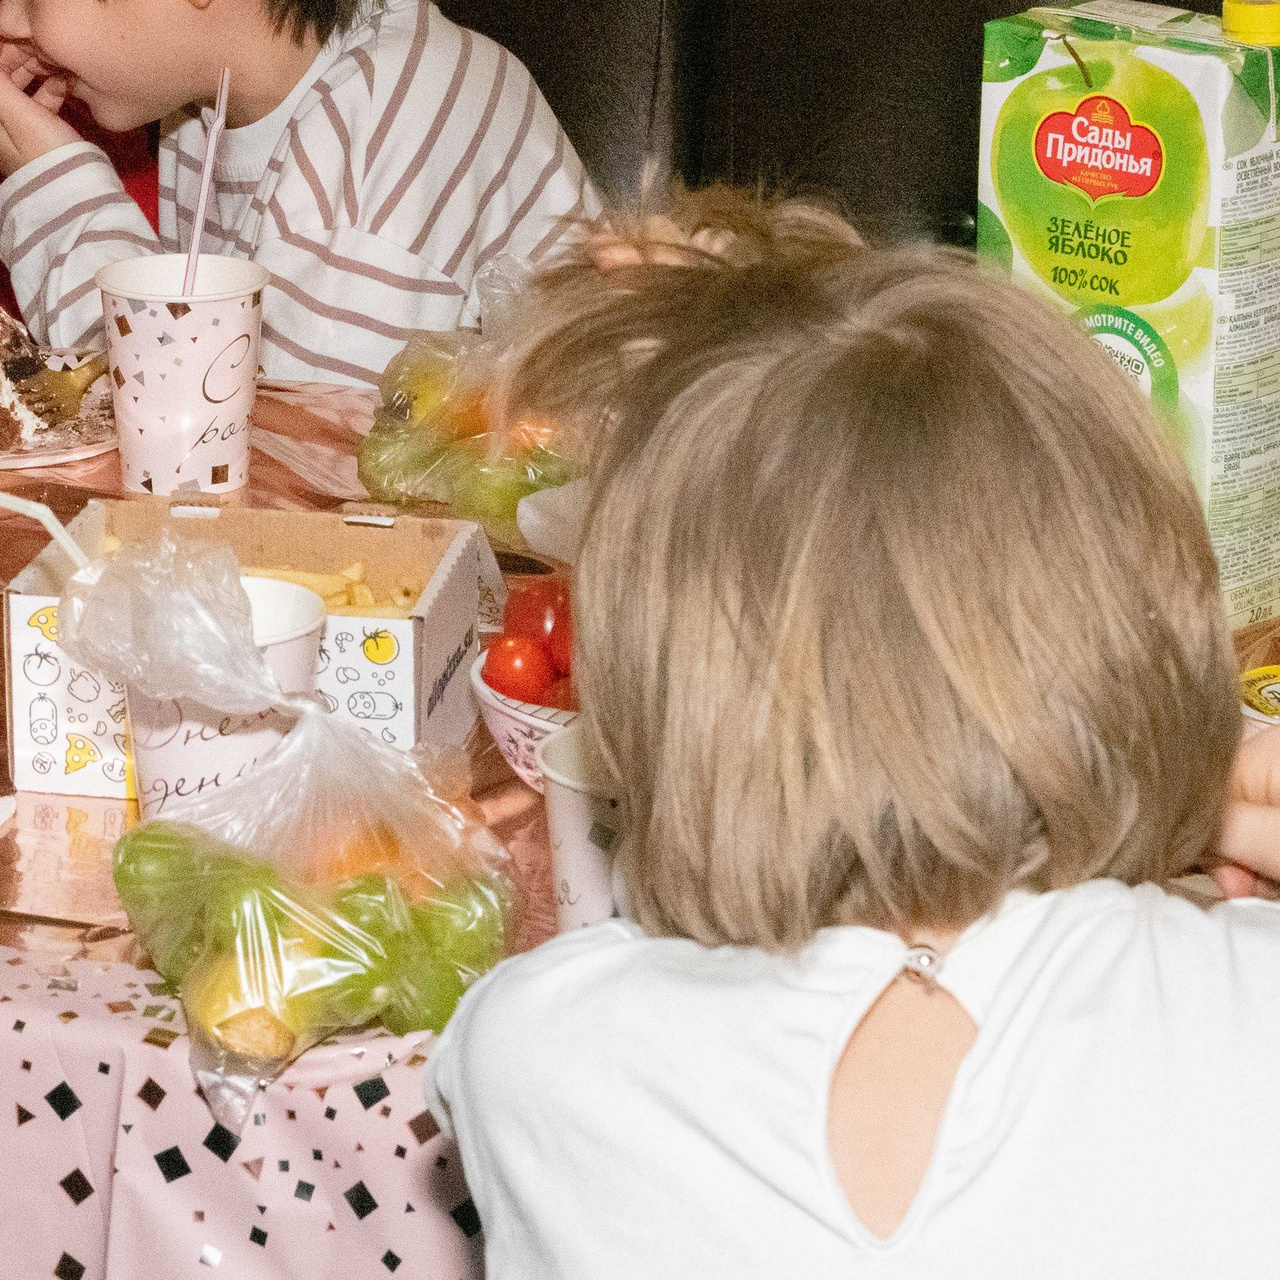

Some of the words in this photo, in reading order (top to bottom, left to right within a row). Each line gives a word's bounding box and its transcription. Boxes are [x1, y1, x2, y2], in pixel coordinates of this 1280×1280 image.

[1071, 116, 1132, 151] Сады
[1045, 132, 1153, 176] Придонья
[1047, 216, 1132, 248] ЗЕЛЁНОЕ
[1048, 235, 1128, 266] ЯБЛОКО
[1051, 266, 1088, 290] 100%
[1089, 274, 1120, 296] СОК
[1083, 313, 1136, 336] МОТРИТЕ
[1133, 328, 1165, 368] ВИДЕО
